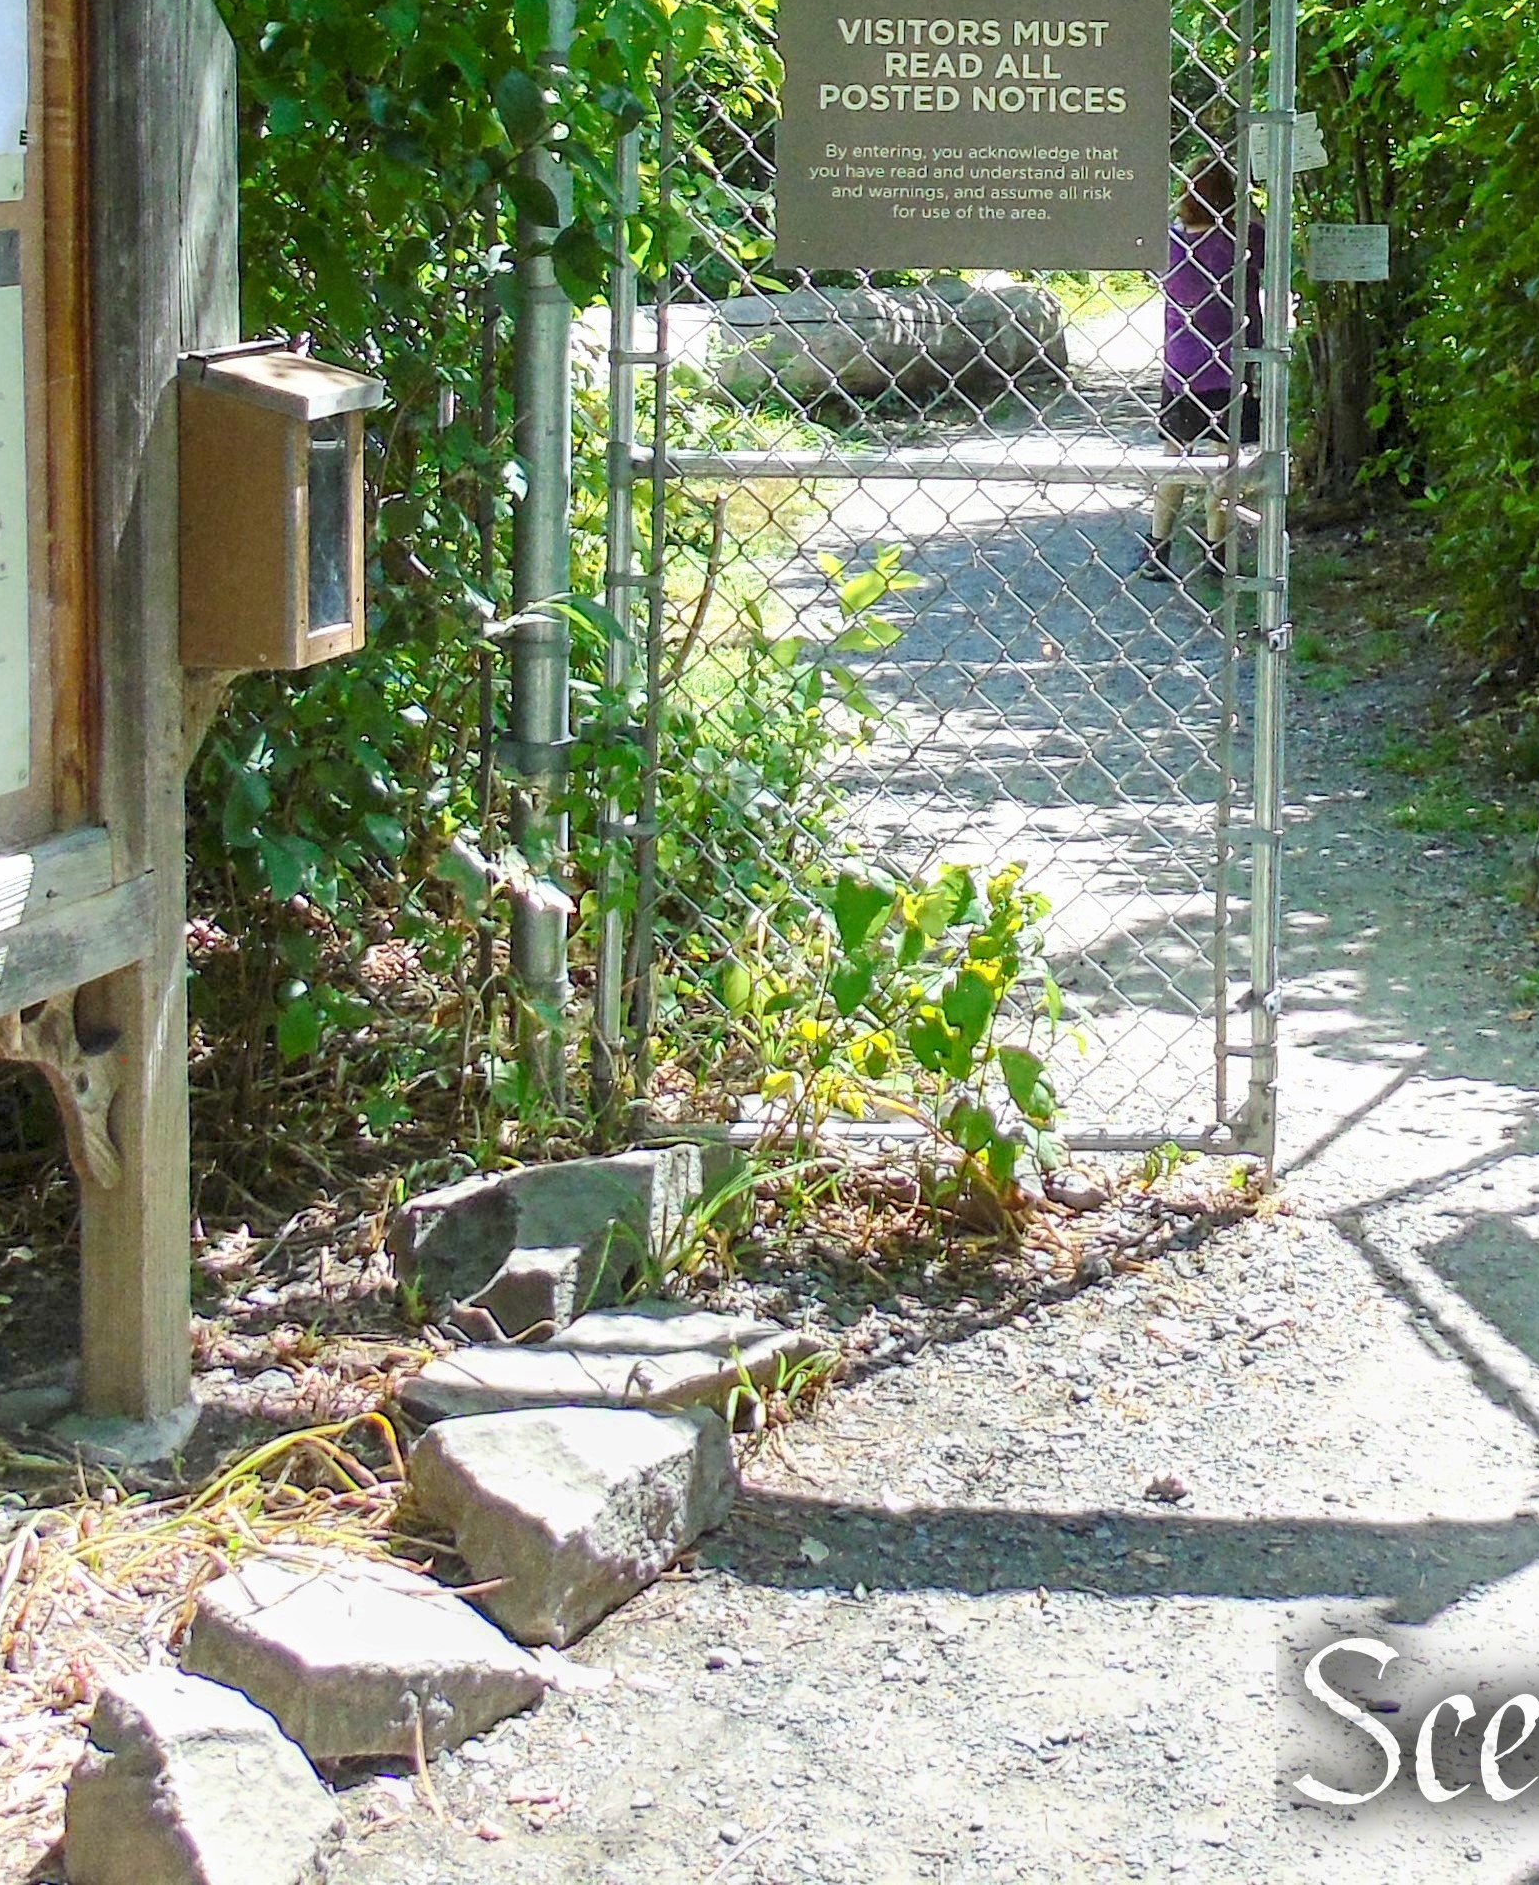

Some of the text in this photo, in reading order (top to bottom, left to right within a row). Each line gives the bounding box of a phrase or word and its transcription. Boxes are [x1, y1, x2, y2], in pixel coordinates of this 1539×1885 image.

[837, 18, 1109, 47] VISITORS MUST
[885, 52, 1062, 79] READ ALL
[819, 84, 1127, 114] POSTED NOTICES
[825, 143, 1118, 162] By entering, you acknowledge that
[809, 165, 1134, 181] you have read and understand all rules
[831, 185, 1112, 201] and warnings, and assume all risk
[893, 205, 1051, 220] for use of the area.
